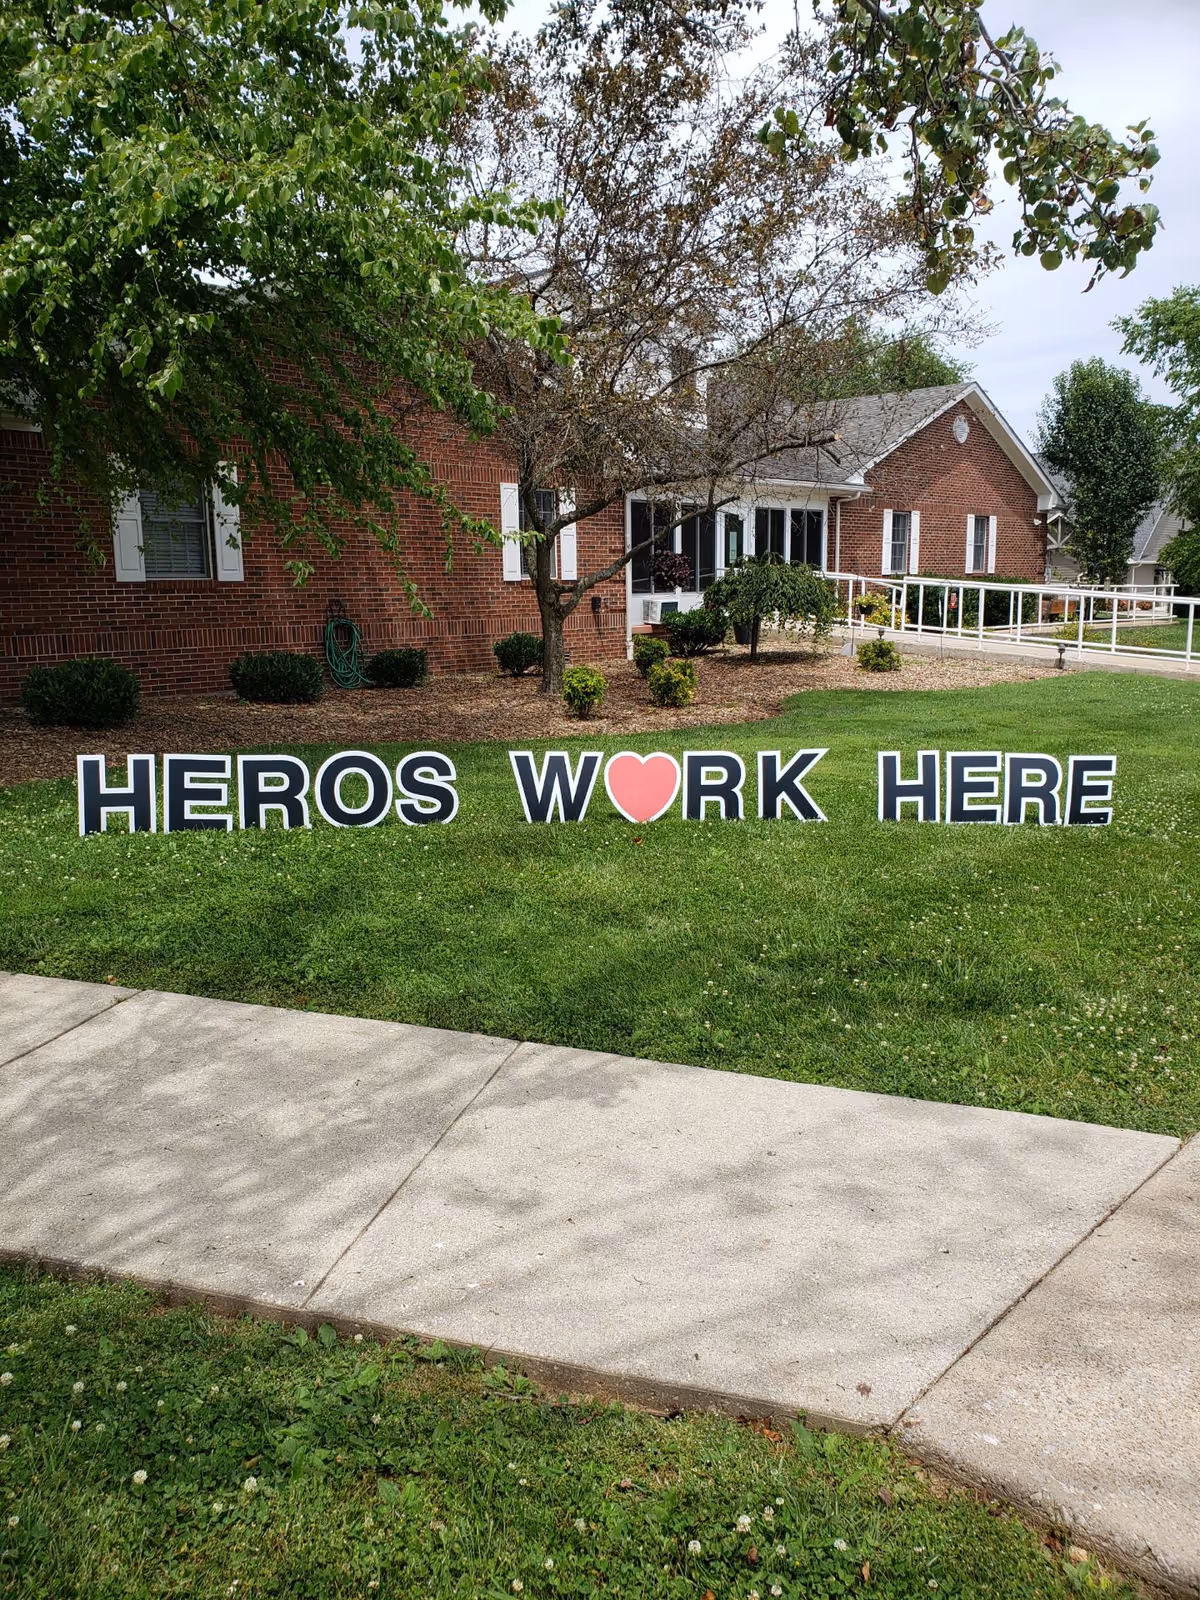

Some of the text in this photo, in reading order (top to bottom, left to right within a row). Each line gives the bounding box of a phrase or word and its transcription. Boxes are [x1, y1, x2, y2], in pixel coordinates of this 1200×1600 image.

[77, 748, 1117, 835] HEROS WRK HERE
